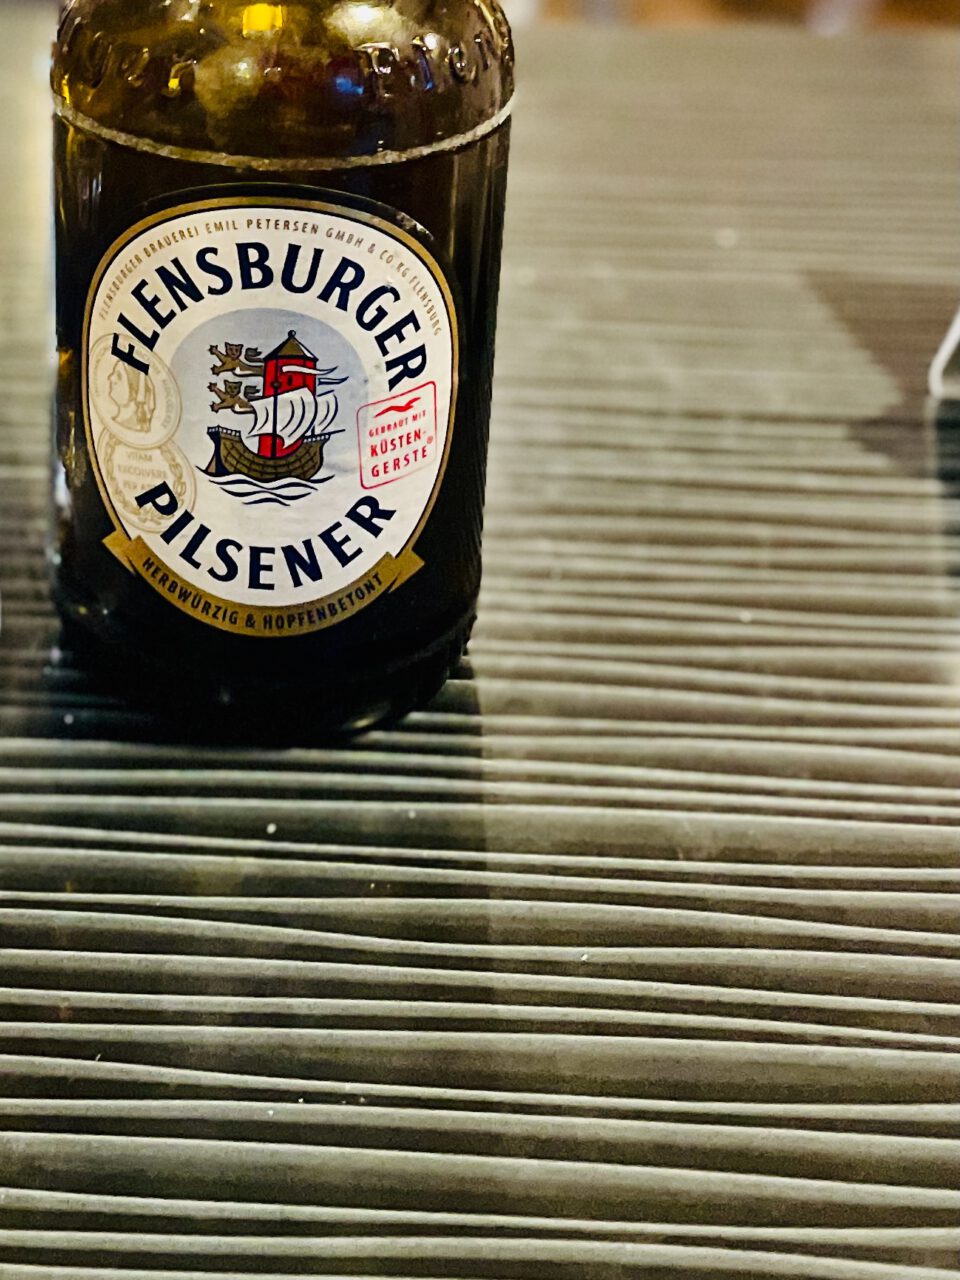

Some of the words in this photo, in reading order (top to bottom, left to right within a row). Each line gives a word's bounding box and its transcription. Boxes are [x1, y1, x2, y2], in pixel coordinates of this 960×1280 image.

[98, 254, 143, 321] FLENSBURGER
[143, 226, 200, 258] BRAUEREI
[205, 220, 239, 234] EMIL
[246, 218, 319, 235] PETERSEN
[367, 243, 376, 254] &
[408, 275, 443, 336] FLENSBURG
[111, 241, 428, 391] FLENSBURGER
[369, 417, 408, 437] GEBRAUT
[412, 410, 426, 422] MIT
[371, 446, 428, 478] GERSTE
[134, 480, 397, 591] PILSENER
[141, 557, 238, 625] HERBWÜRZIG
[245, 613, 256, 628] &
[263, 572, 383, 630] HOPFENBETONT
